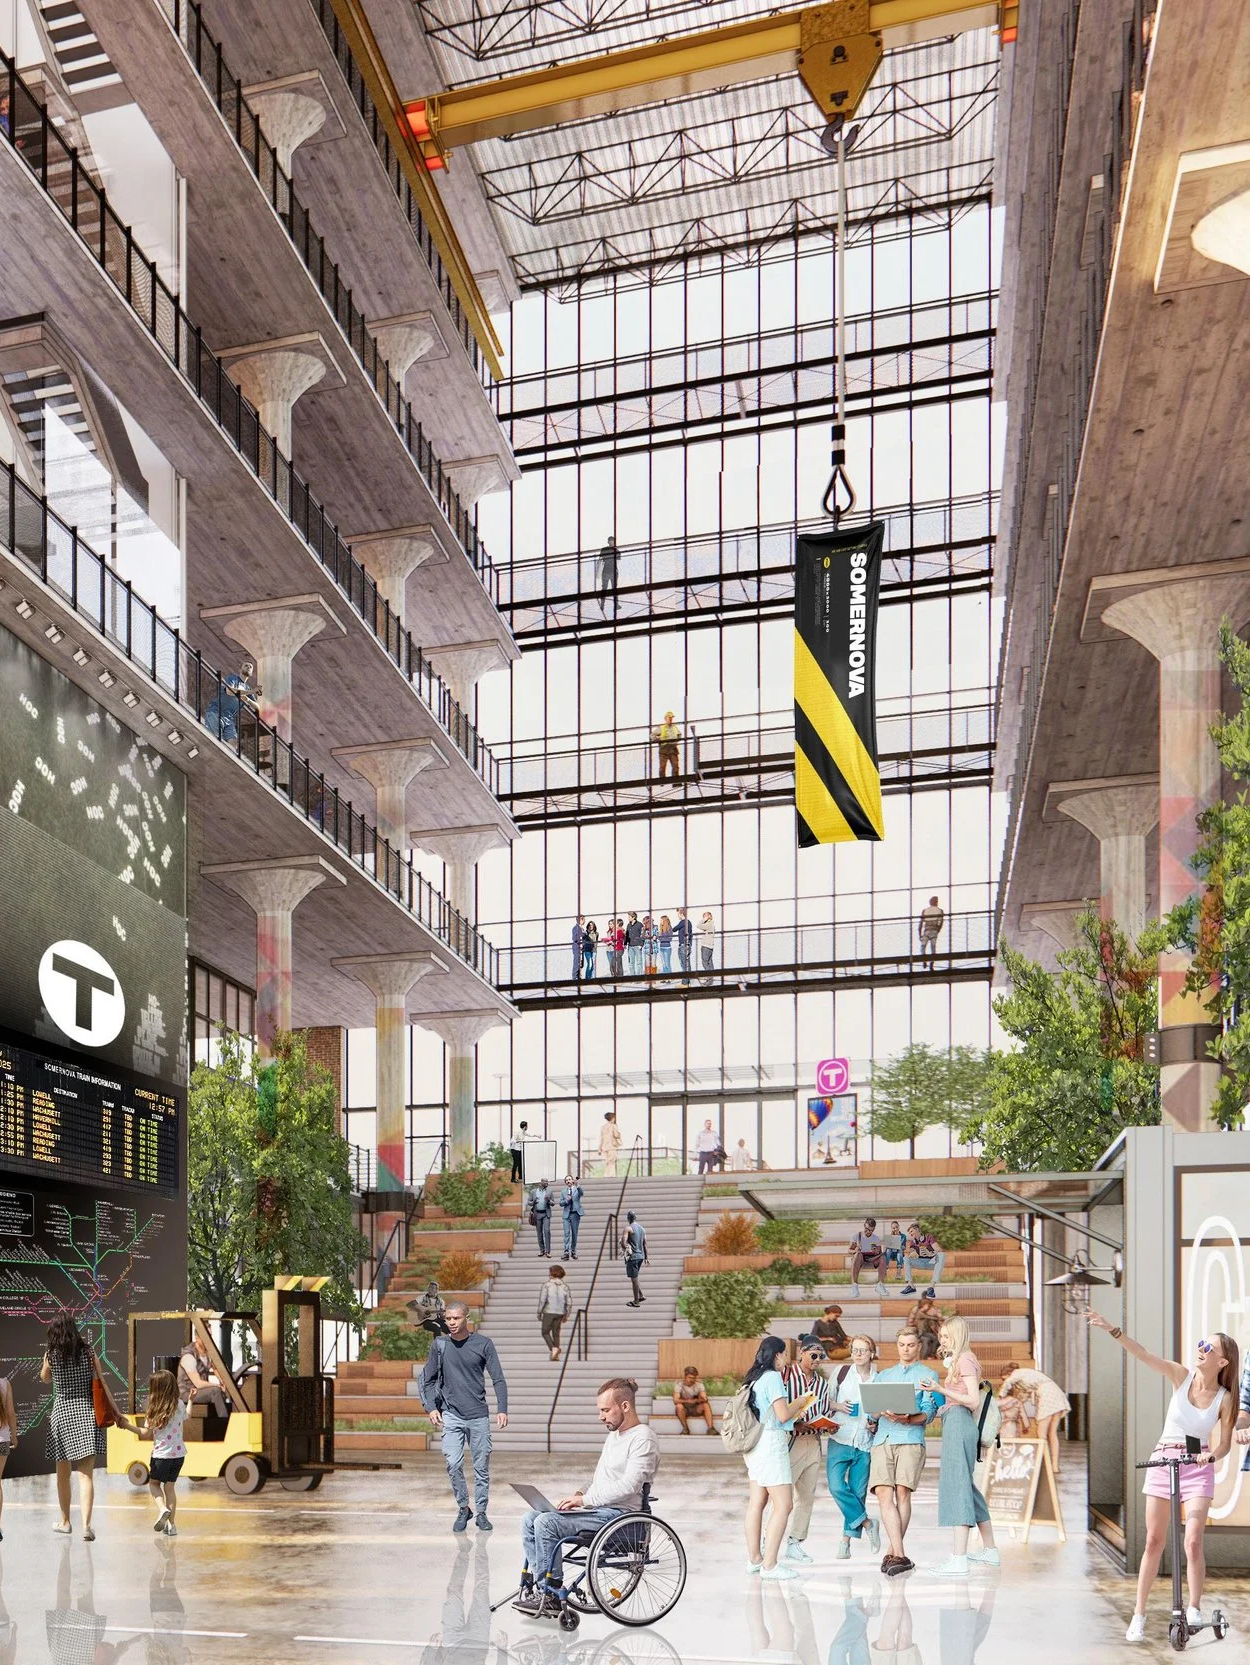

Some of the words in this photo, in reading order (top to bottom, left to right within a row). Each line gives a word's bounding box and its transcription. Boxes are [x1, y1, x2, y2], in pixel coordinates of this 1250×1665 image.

[849, 553, 867, 698] SOMERNOVA
[44, 1062, 76, 1079] SOMERNOVA
[91, 1076, 122, 1092] INFORMATION
[135, 1088, 159, 1102] CURRENT
[162, 1096, 175, 1107] TIME
